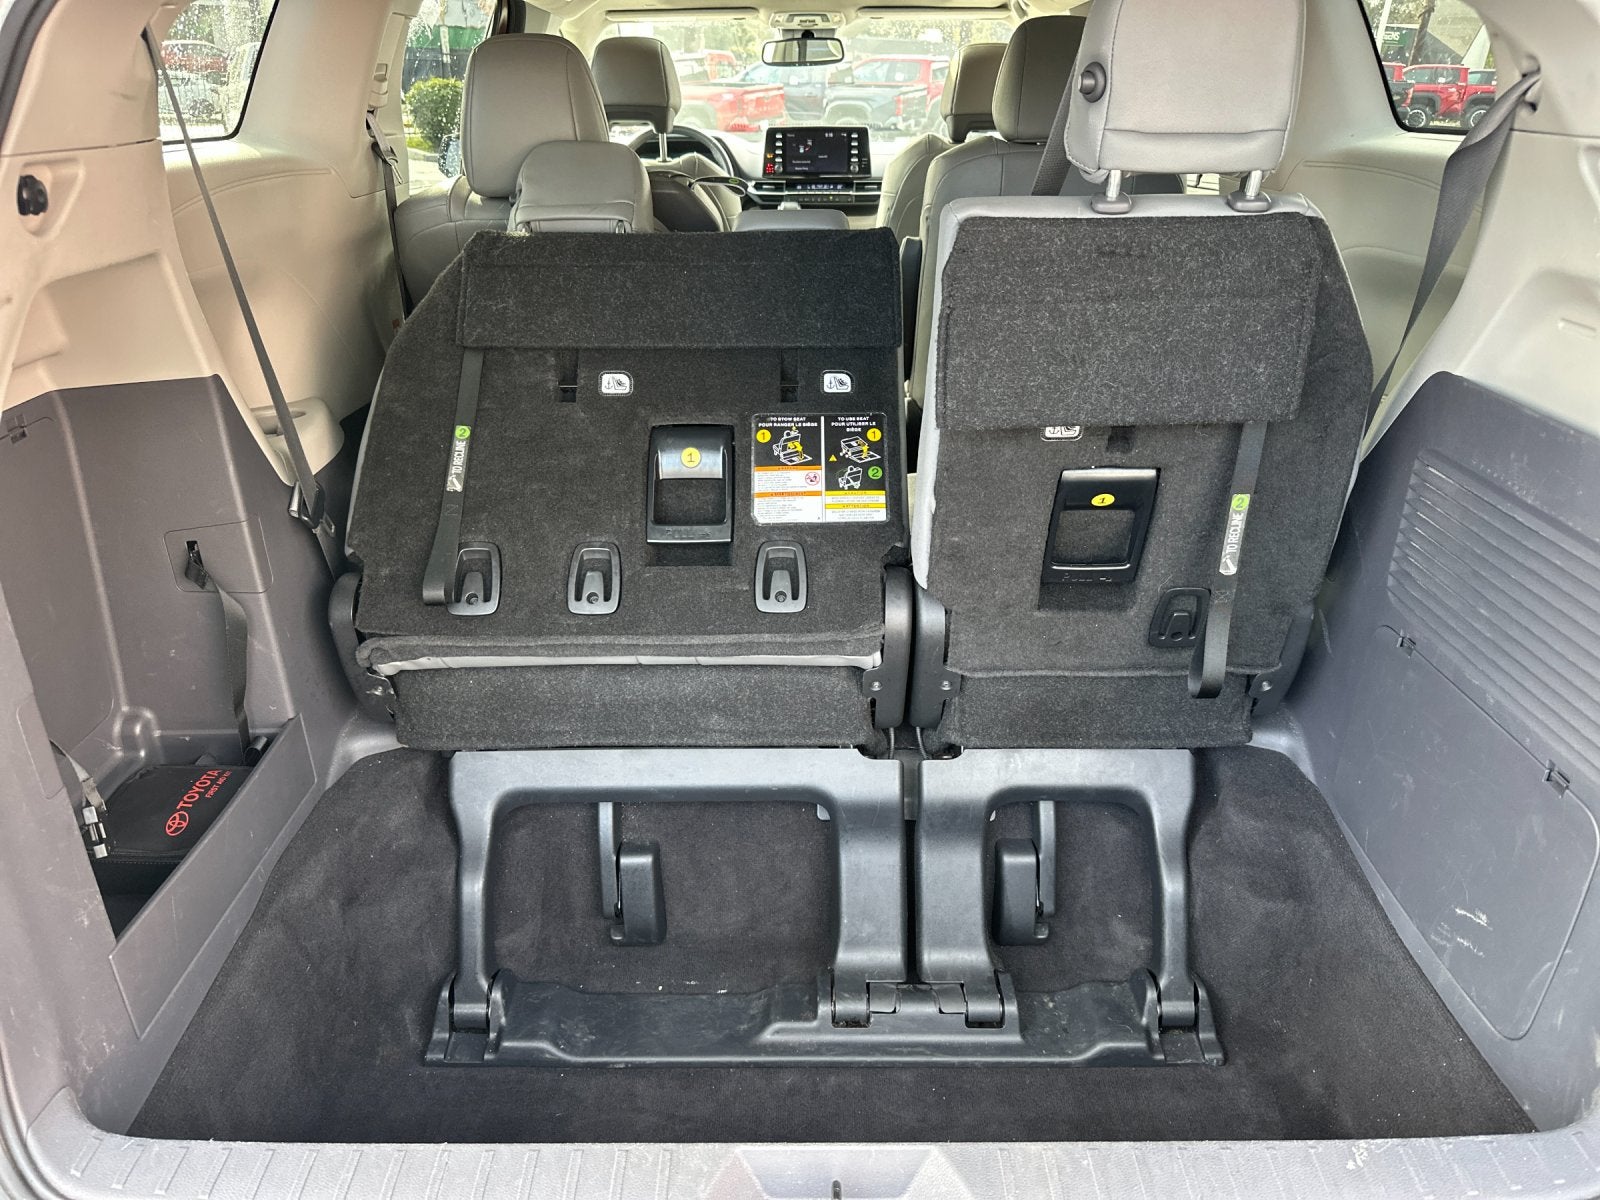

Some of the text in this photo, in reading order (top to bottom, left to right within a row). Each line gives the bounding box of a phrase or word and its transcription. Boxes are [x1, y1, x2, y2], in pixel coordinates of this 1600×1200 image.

[453, 440, 466, 466] RECLINE
[451, 465, 463, 474] TO
[871, 467, 879, 478] 2
[1225, 496, 1245, 554] TO RECLINE 2
[176, 769, 222, 810] TOYOTA
[204, 784, 220, 798] FIRST
